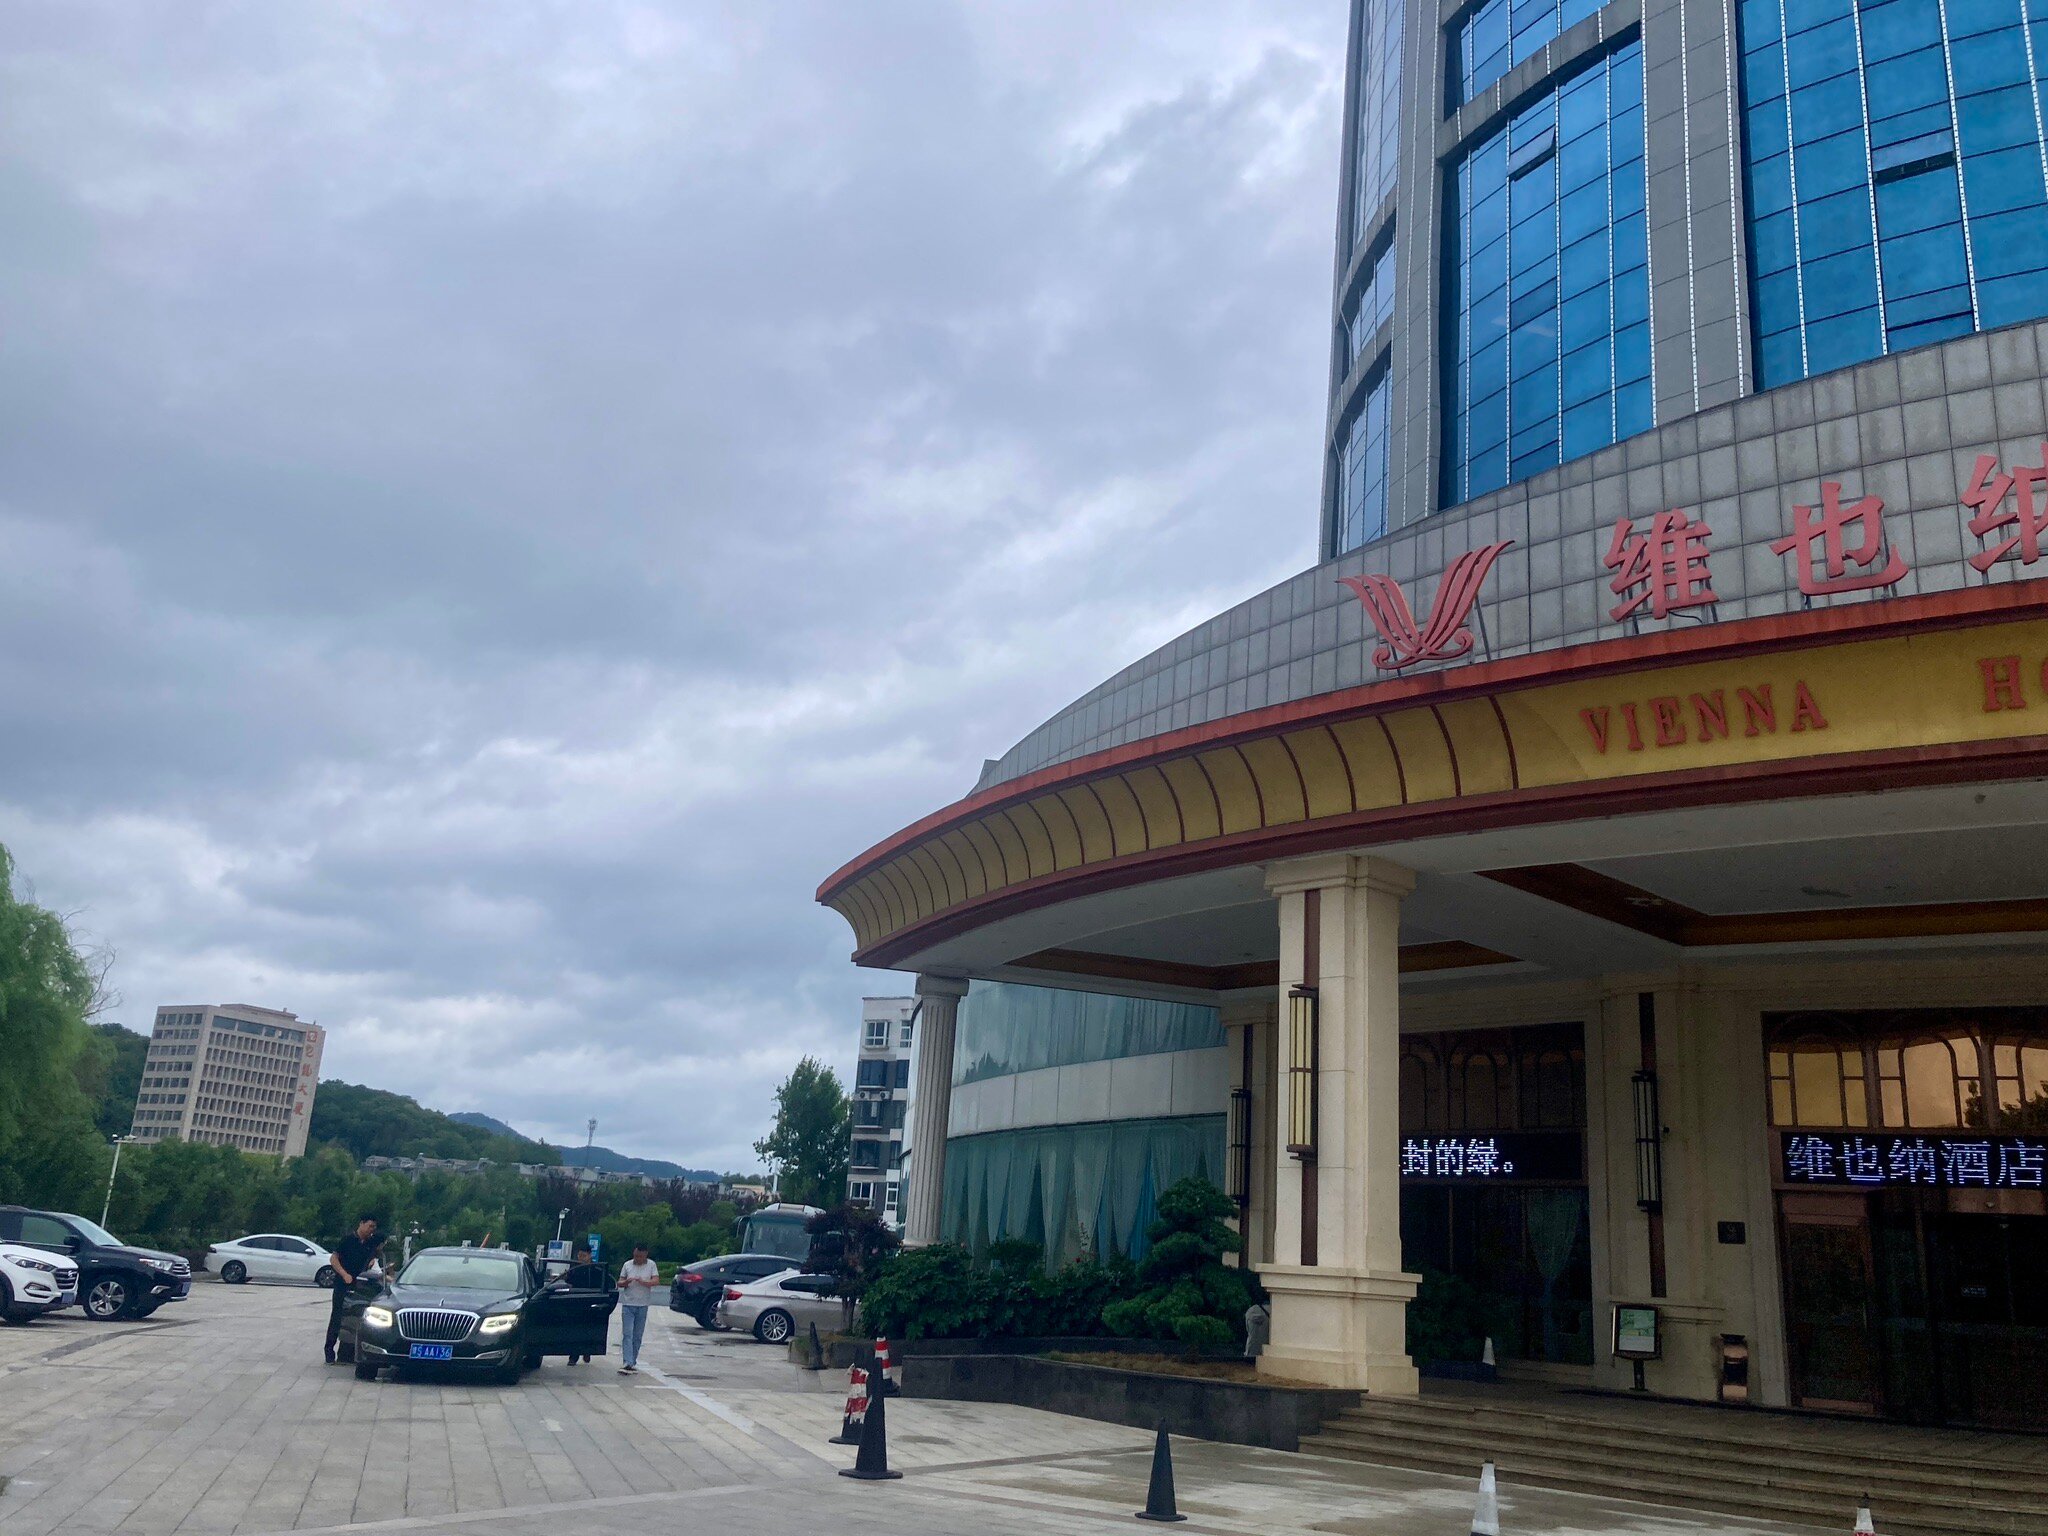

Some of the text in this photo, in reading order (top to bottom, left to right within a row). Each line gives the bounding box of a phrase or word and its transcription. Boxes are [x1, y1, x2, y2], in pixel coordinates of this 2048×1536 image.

[1603, 442, 2048, 623] 维也纳
[1580, 655, 2048, 755] VIENNA H
[1787, 1135, 2047, 1186] 维也纳酒店
